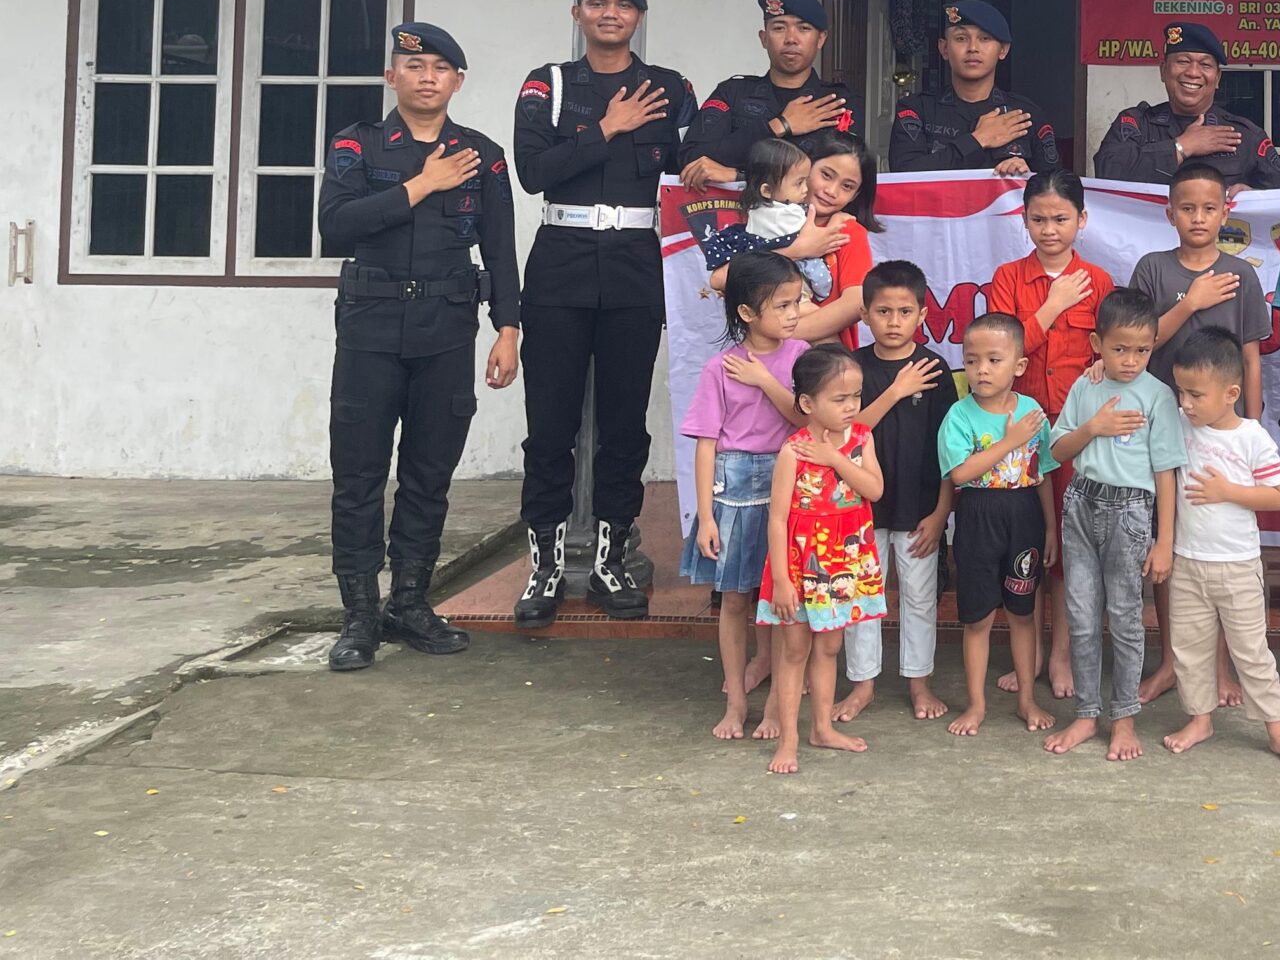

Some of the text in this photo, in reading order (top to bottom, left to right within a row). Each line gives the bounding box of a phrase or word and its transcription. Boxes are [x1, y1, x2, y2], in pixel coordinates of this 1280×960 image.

[1153, 0, 1225, 14] REKENING
[1239, 2, 1260, 14] BRI
[1238, 18, 1260, 30] An.
[1098, 40, 1159, 59] HP/WA.
[925, 124, 960, 137] RIZKY
[686, 200, 713, 214] KORPS
